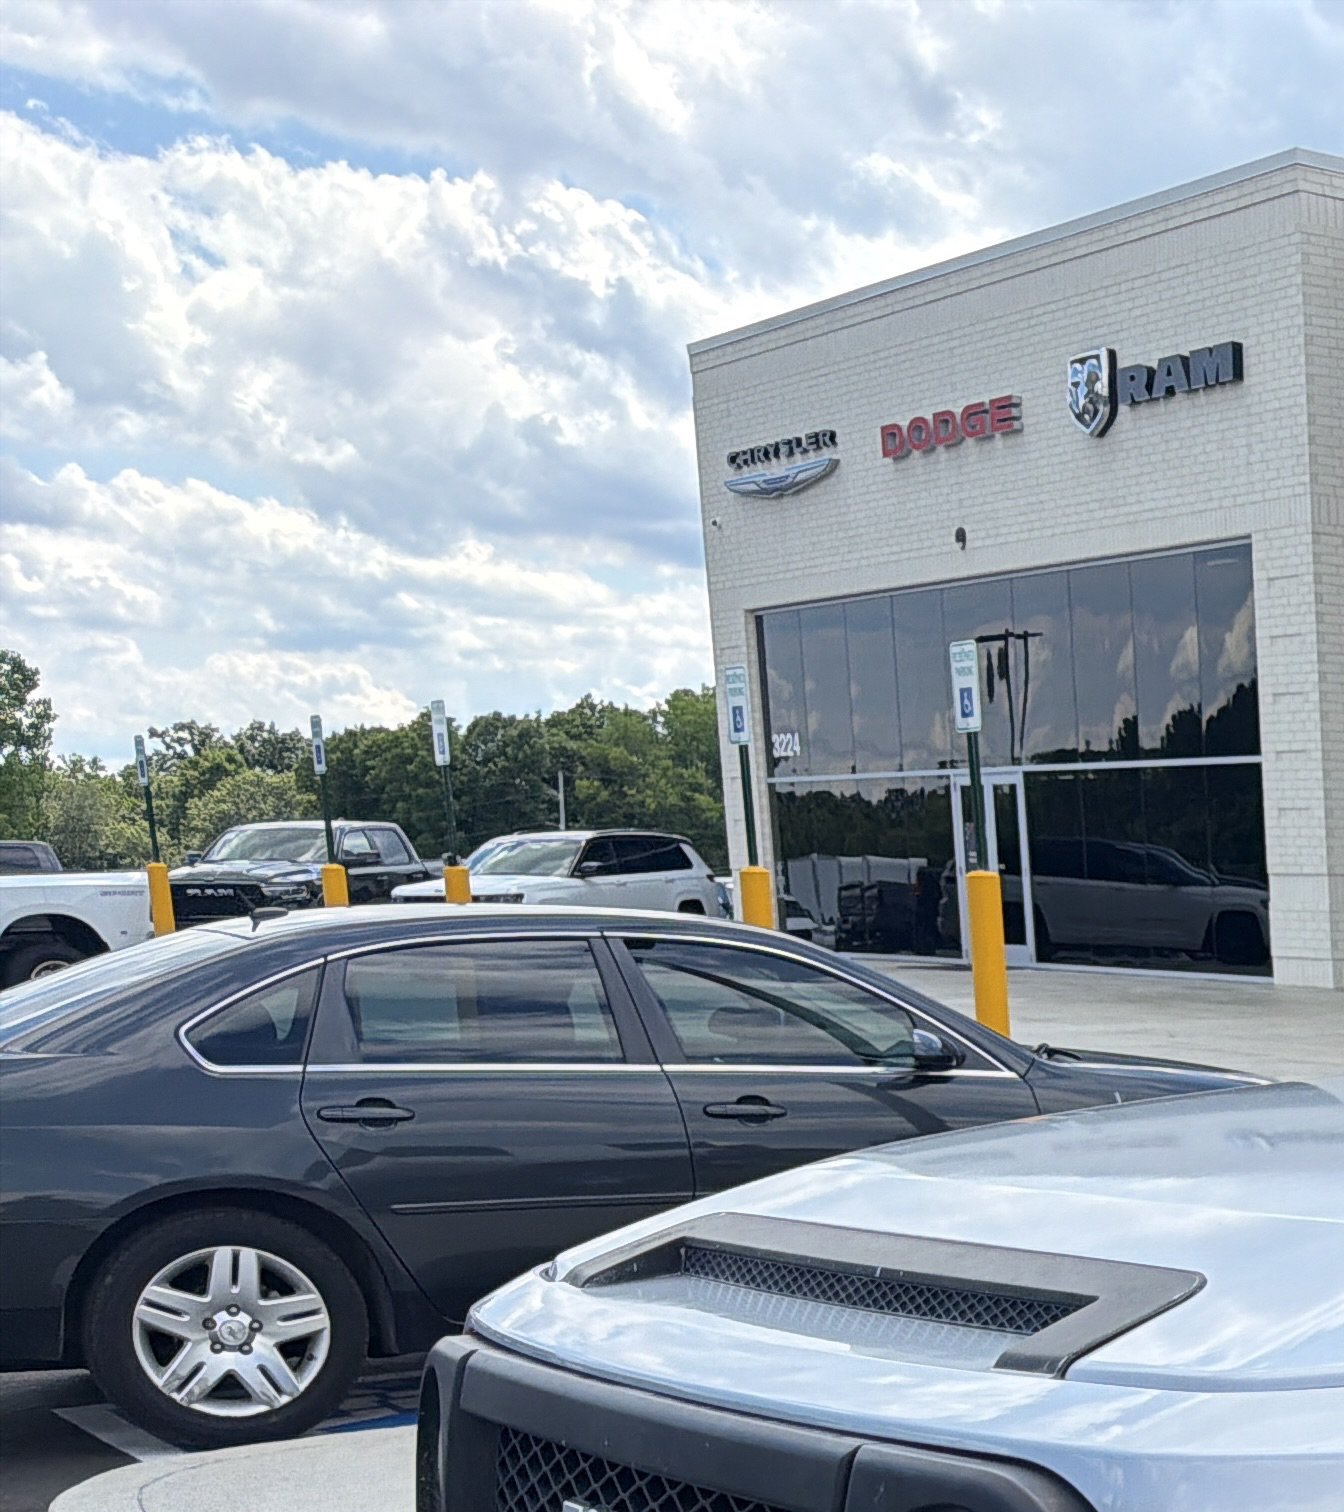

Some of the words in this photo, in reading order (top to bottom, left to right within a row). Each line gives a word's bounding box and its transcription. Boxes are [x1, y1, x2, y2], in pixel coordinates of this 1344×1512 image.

[1117, 341, 1243, 405] RAM
[727, 429, 838, 471] CHRYSLER
[880, 394, 1024, 460] DODGE
[771, 732, 801, 758] 3224
